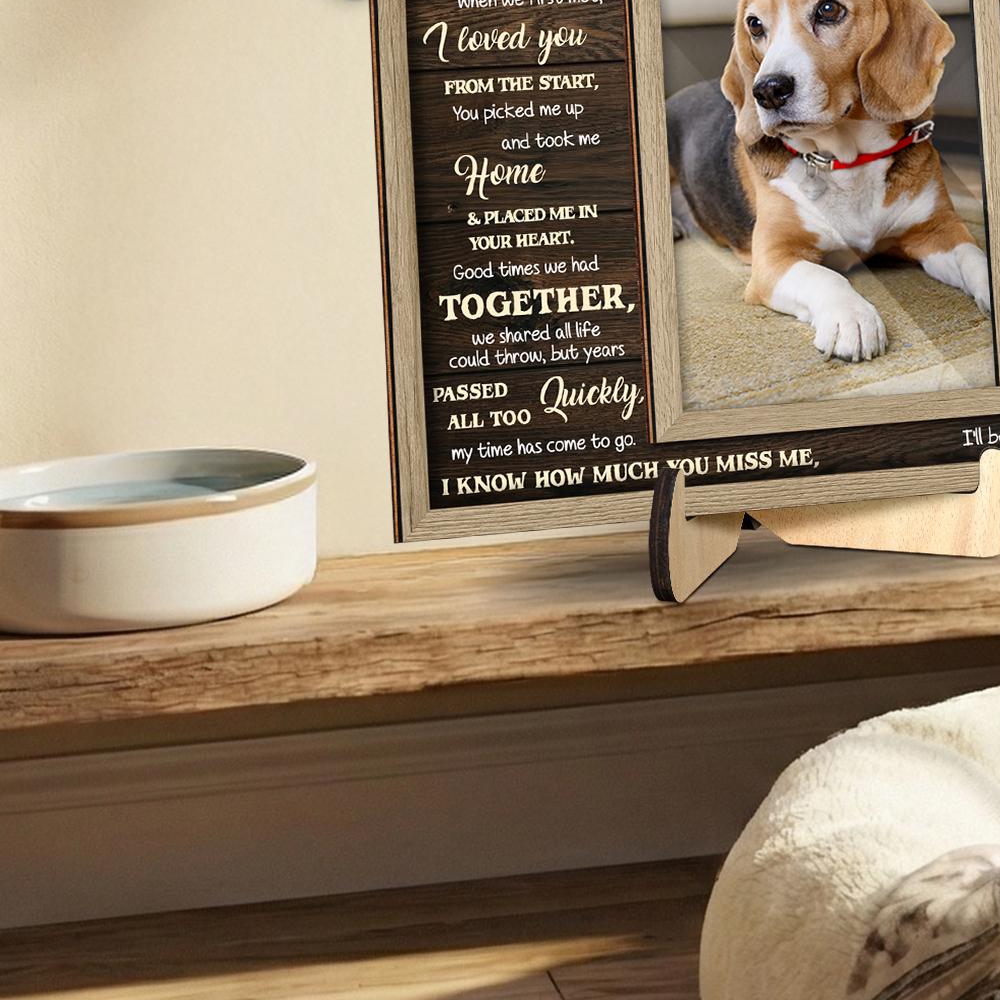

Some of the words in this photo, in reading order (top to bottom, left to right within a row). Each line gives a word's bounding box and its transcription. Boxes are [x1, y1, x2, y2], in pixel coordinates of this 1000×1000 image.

[423, 21, 449, 62] I
[458, 23, 531, 52] loved
[538, 26, 587, 65] you
[444, 78, 494, 95] FROM
[498, 76, 533, 92] THE
[539, 73, 599, 90] START,
[501, 133, 531, 150] and
[535, 130, 575, 148] took
[579, 134, 600, 146] me
[454, 154, 546, 200] Home
[467, 212, 481, 225] &
[484, 208, 546, 225] PLACED
[549, 206, 575, 220] ME
[578, 204, 598, 218] IN
[453, 261, 494, 280] Good
[498, 261, 540, 277] times
[544, 262, 567, 274] we
[571, 254, 600, 272] had
[439, 284, 635, 321] TOGETHER,
[472, 333, 495, 345] we
[499, 324, 551, 343] shared
[555, 322, 572, 339] all
[576, 321, 601, 338] life
[433, 382, 508, 402] PASSED
[451, 448, 473, 464] my
[477, 442, 513, 458] time
[517, 438, 542, 455] has
[546, 438, 586, 452] come
[590, 433, 610, 449] to
[615, 435, 636, 452] go.
[962, 427, 983, 446] I'll
